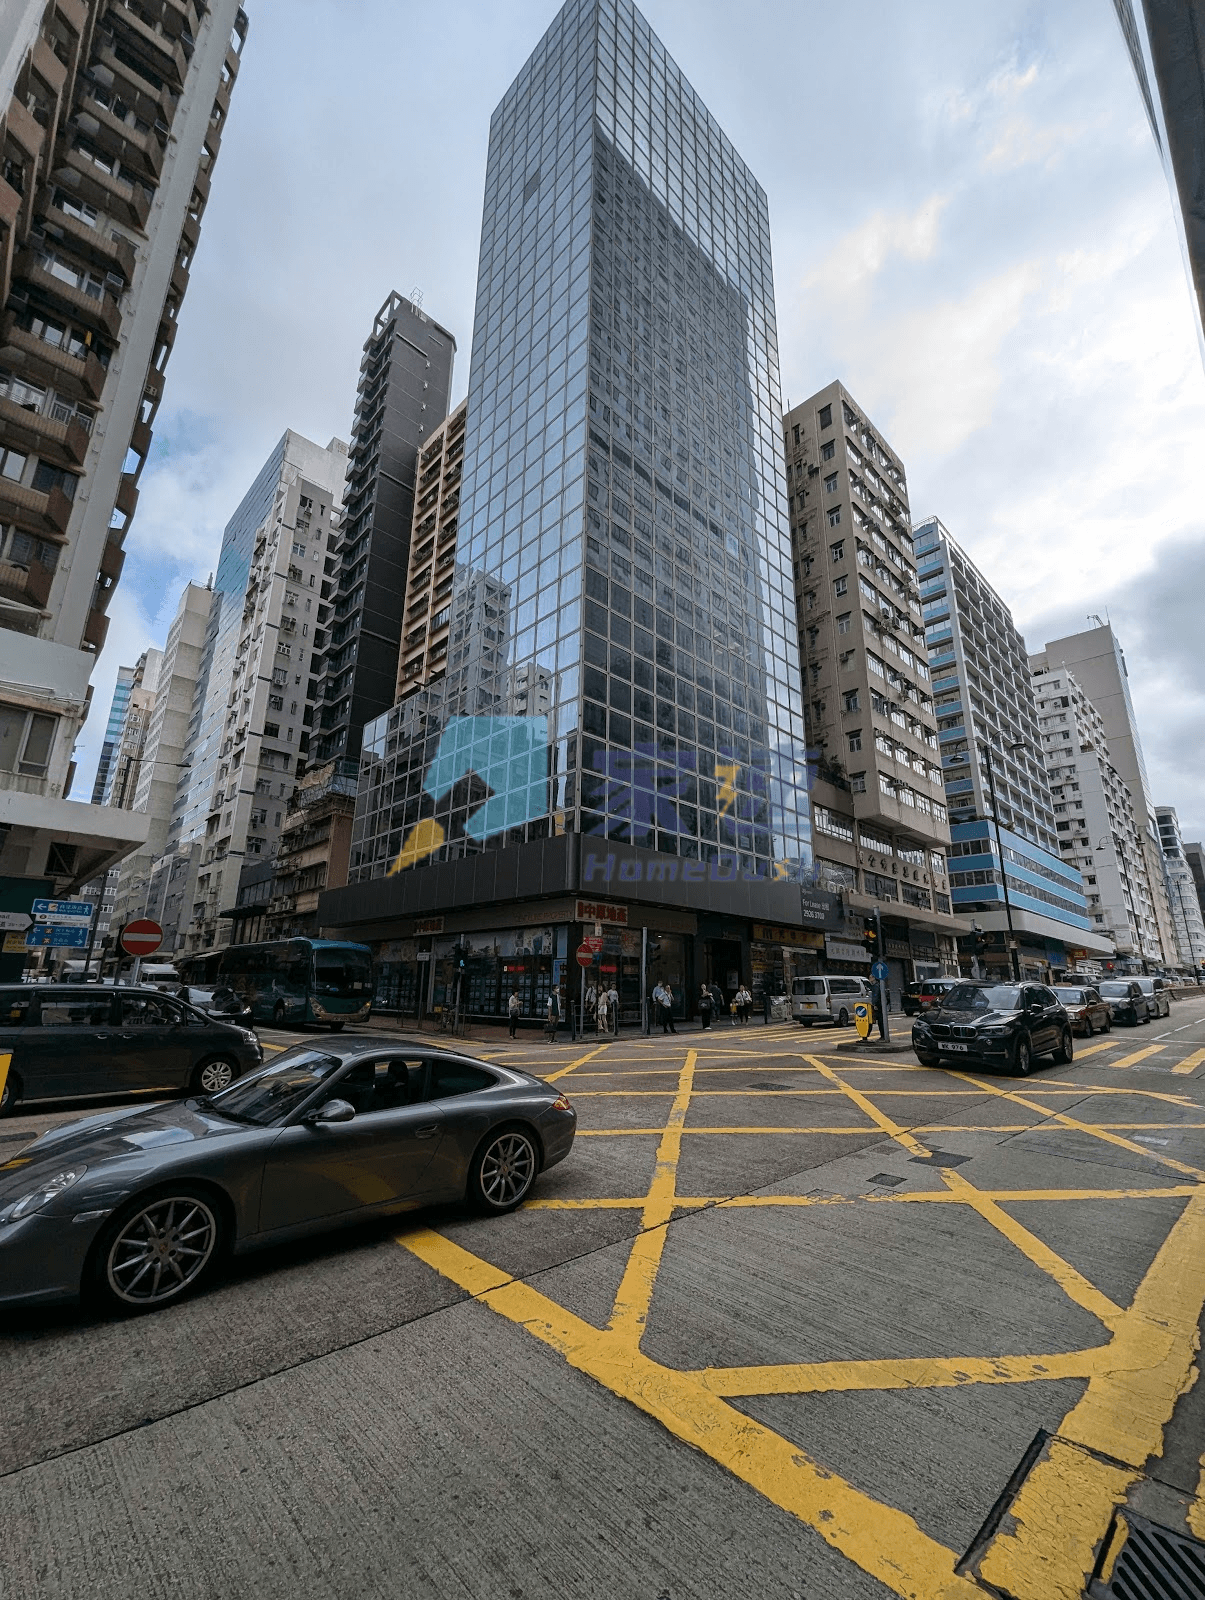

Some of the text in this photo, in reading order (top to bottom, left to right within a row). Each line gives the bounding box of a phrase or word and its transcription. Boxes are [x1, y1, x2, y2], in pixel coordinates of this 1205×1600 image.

[811, 901, 821, 909] Lease
[583, 903, 628, 922] 中原地產
